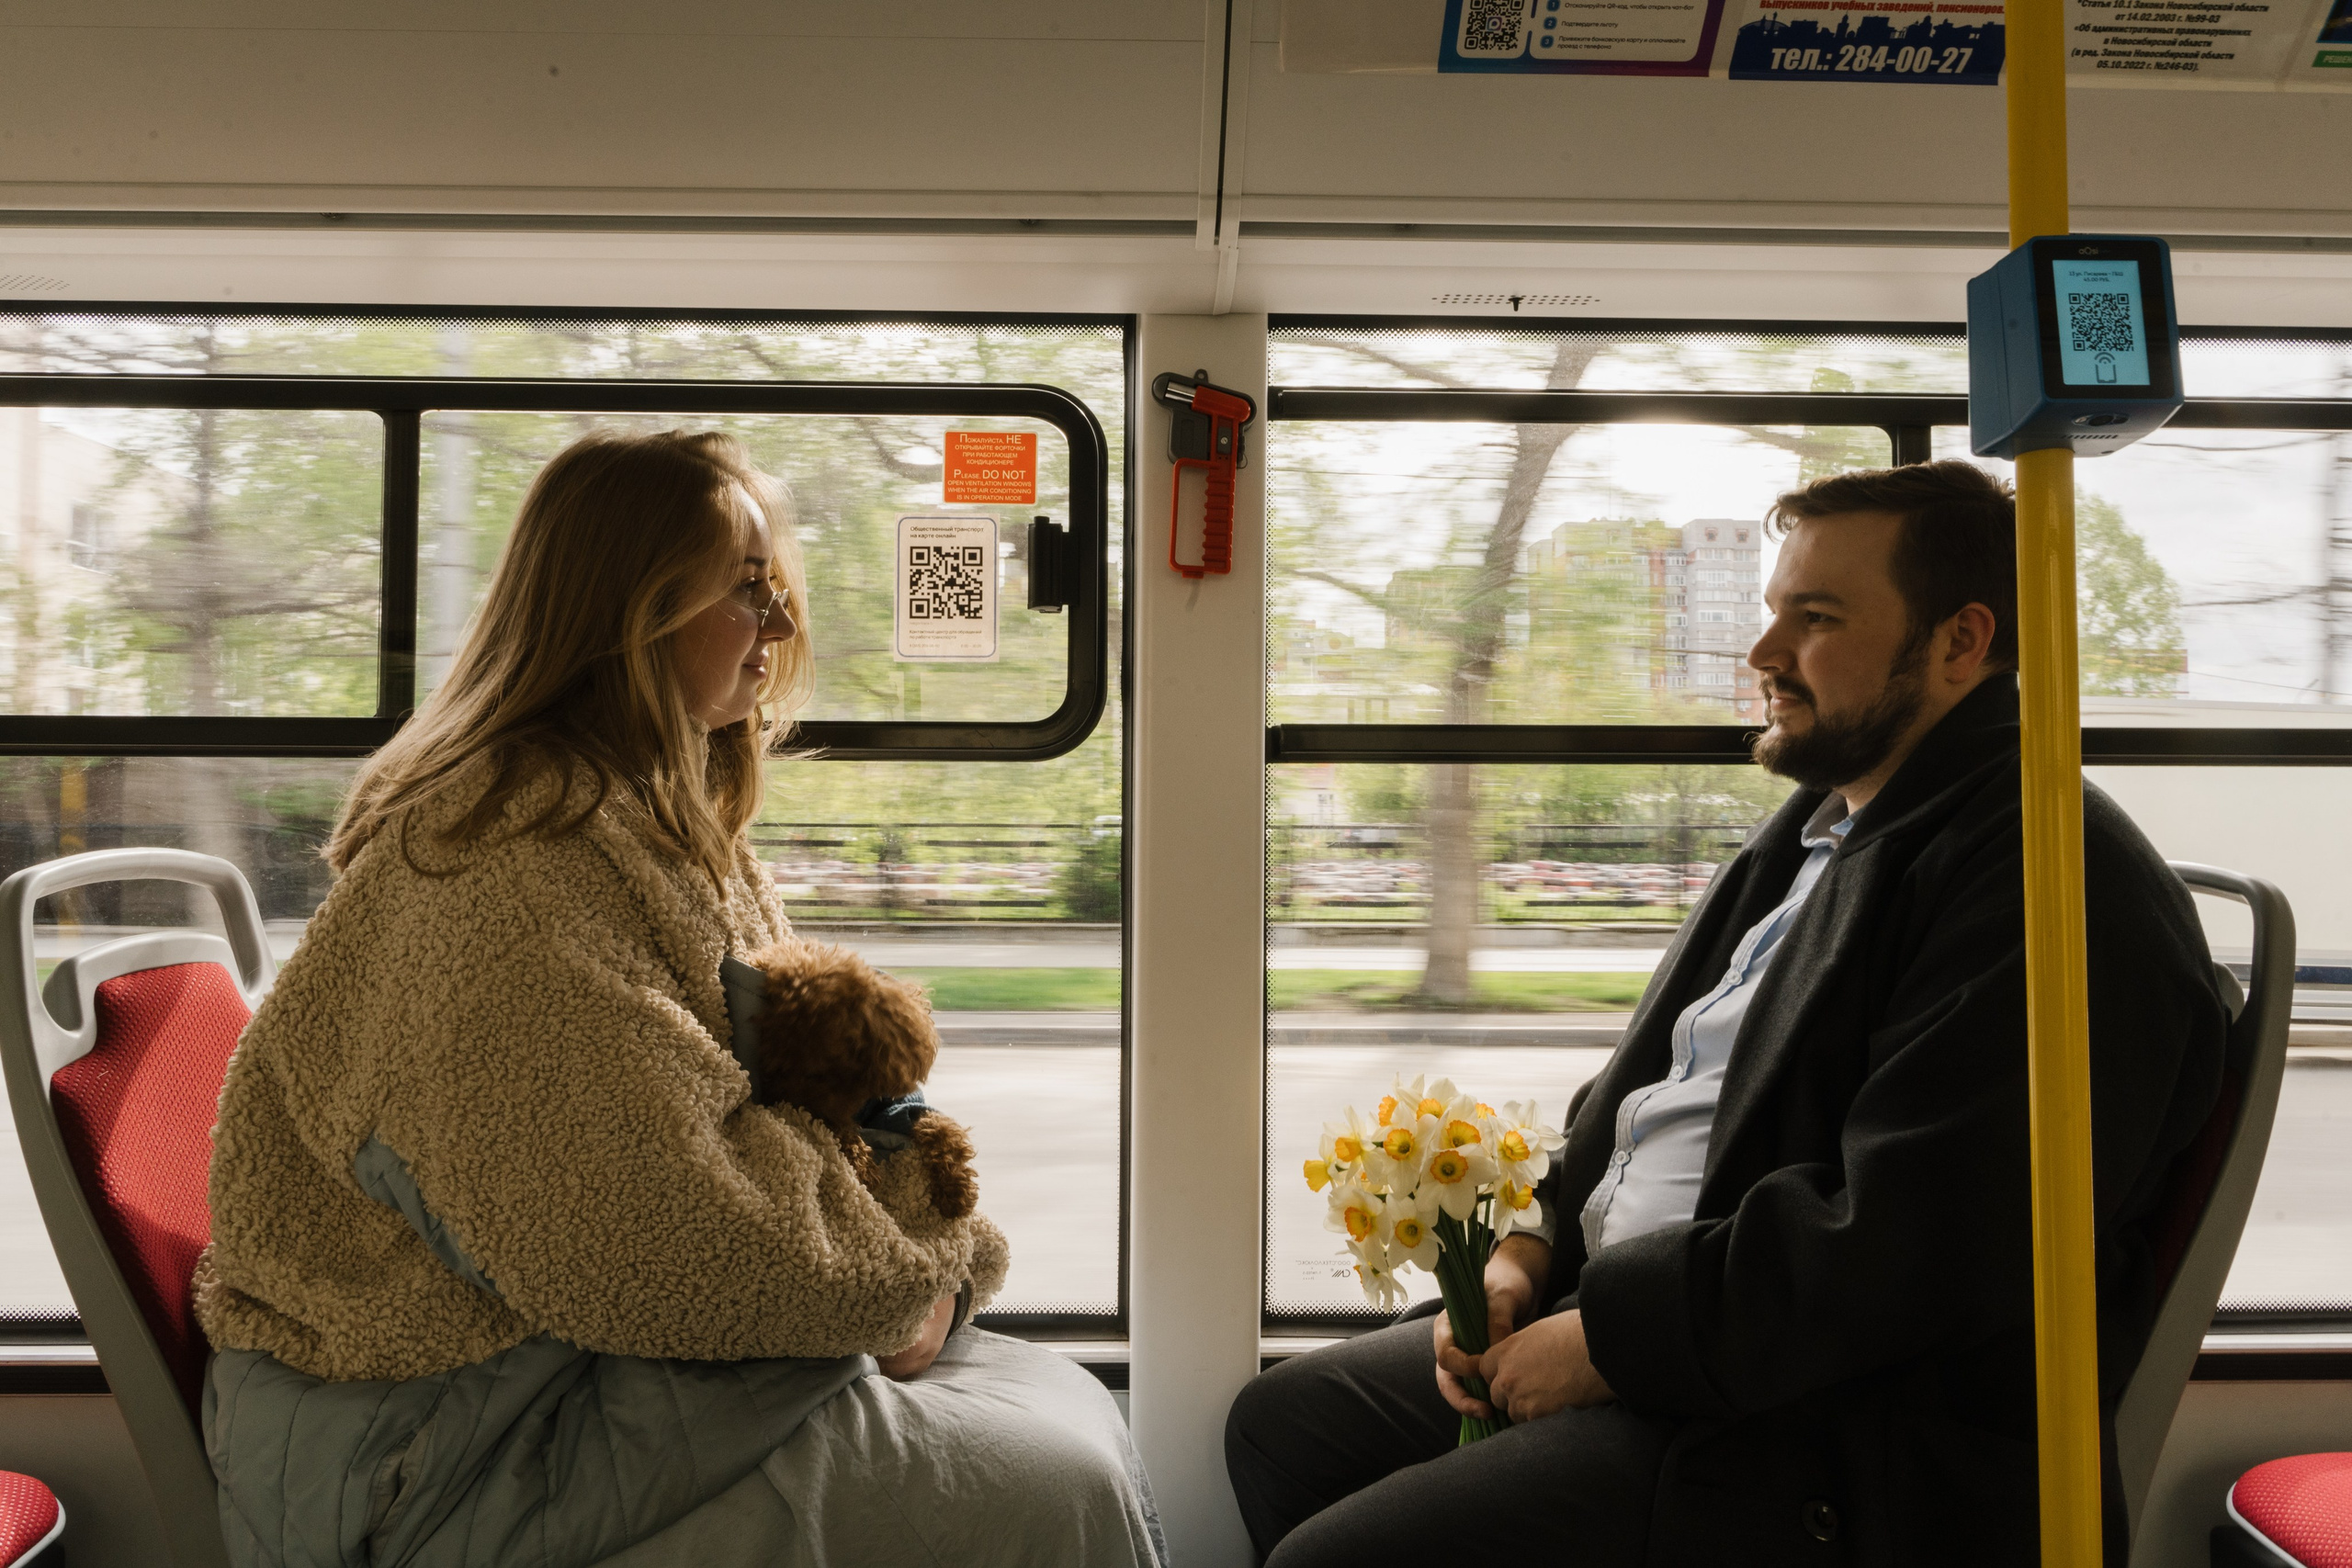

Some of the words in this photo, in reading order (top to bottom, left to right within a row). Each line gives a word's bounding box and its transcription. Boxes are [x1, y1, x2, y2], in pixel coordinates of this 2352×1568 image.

[1760, 0, 1829, 9] выпускников
[1830, 0, 1875, 11] учебных
[1877, 1, 1934, 13] заведений,
[2133, 1, 2165, 9] Закона
[2166, 1, 2233, 12] Новосибирской
[2234, 3, 2269, 12] области
[2127, 13, 2177, 21] 14.02.2003
[2092, 25, 2174, 34] административных
[2111, 36, 2178, 47] Новосибирской
[2178, 38, 2212, 47] области
[1771, 47, 1832, 71] тел.:
[1835, 45, 1973, 73] 284-00-27
[2101, 49, 2132, 57] Закона
[2133, 50, 2200, 60] Новосибирской
[2200, 51, 2235, 59] области
[2097, 60, 2146, 69] 05.10.2022
[1006, 435, 1022, 444] НЕ
[982, 470, 999, 479] DO
[1002, 470, 1026, 480] NOT
